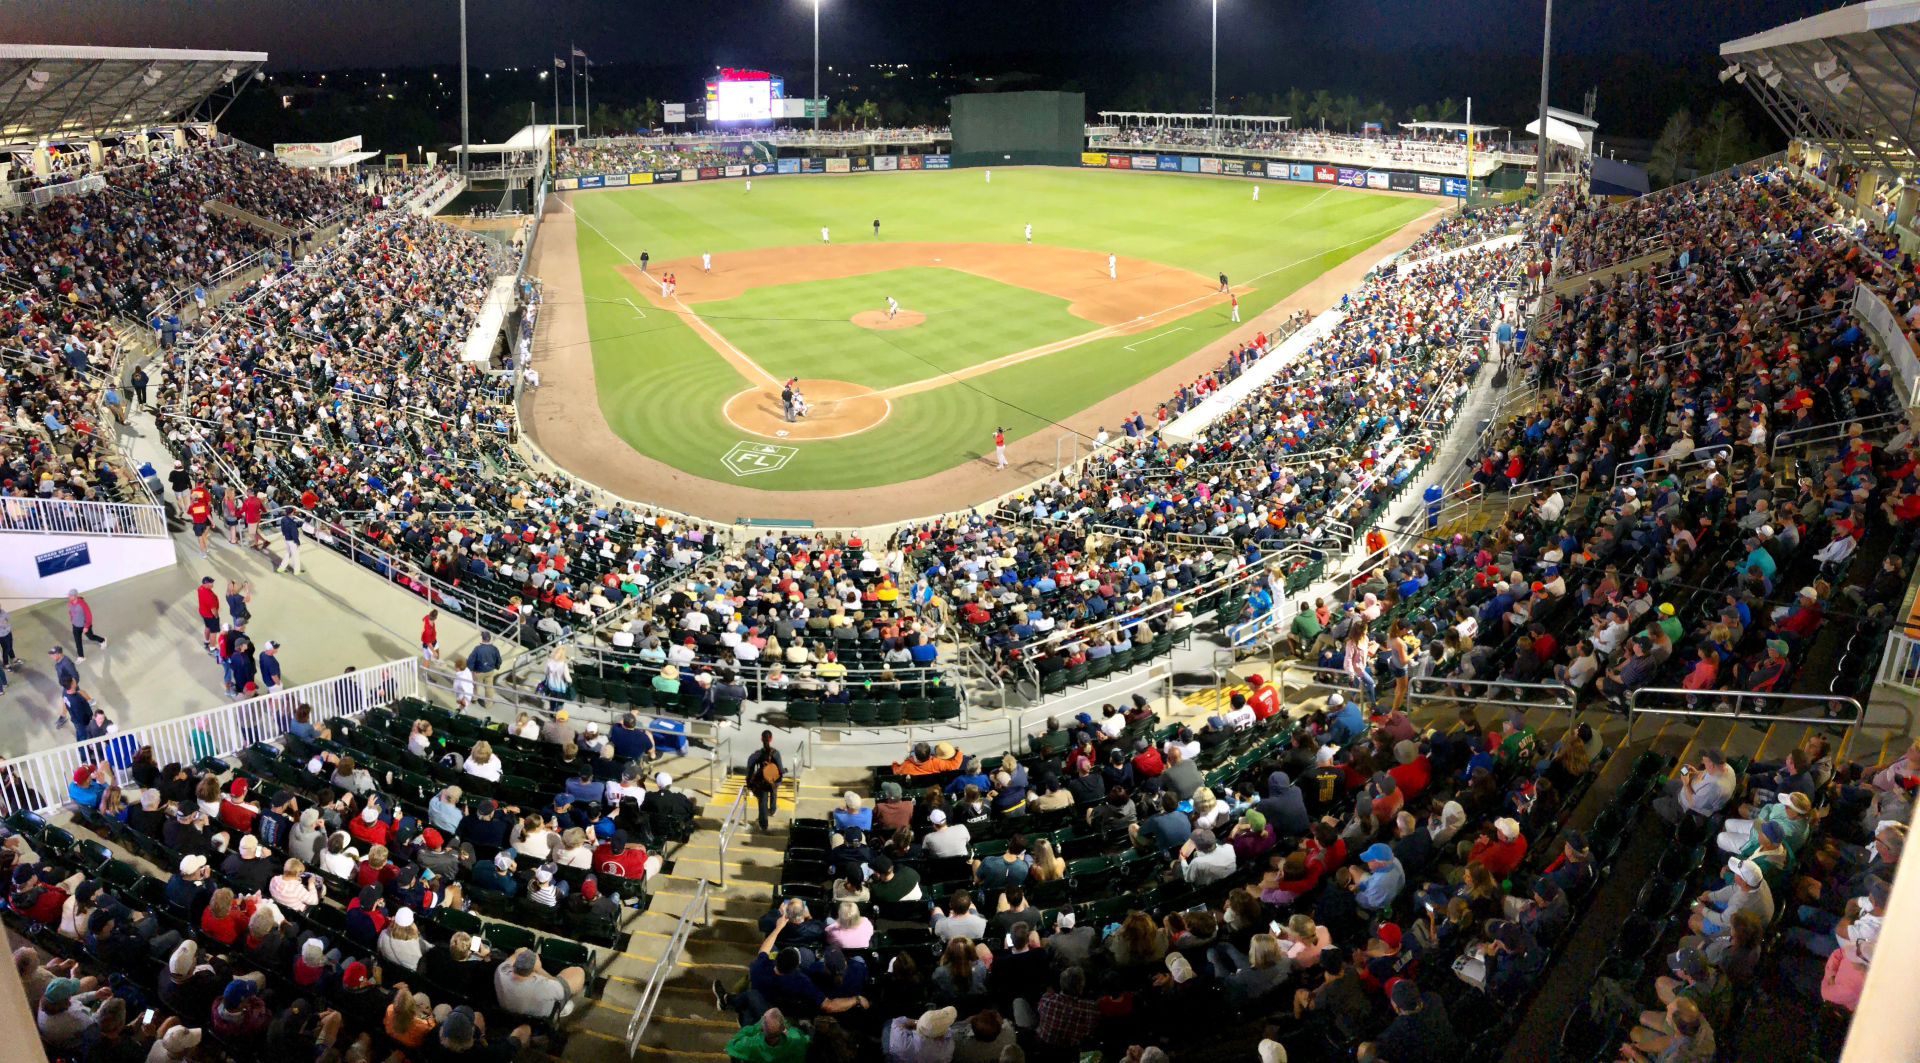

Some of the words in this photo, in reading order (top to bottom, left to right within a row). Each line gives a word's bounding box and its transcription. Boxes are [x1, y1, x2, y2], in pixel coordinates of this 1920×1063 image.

[286, 145, 299, 154] Salty
[312, 145, 321, 154] Bar
[736, 453, 770, 467] FL
[1265, 697, 1273, 713] 7
